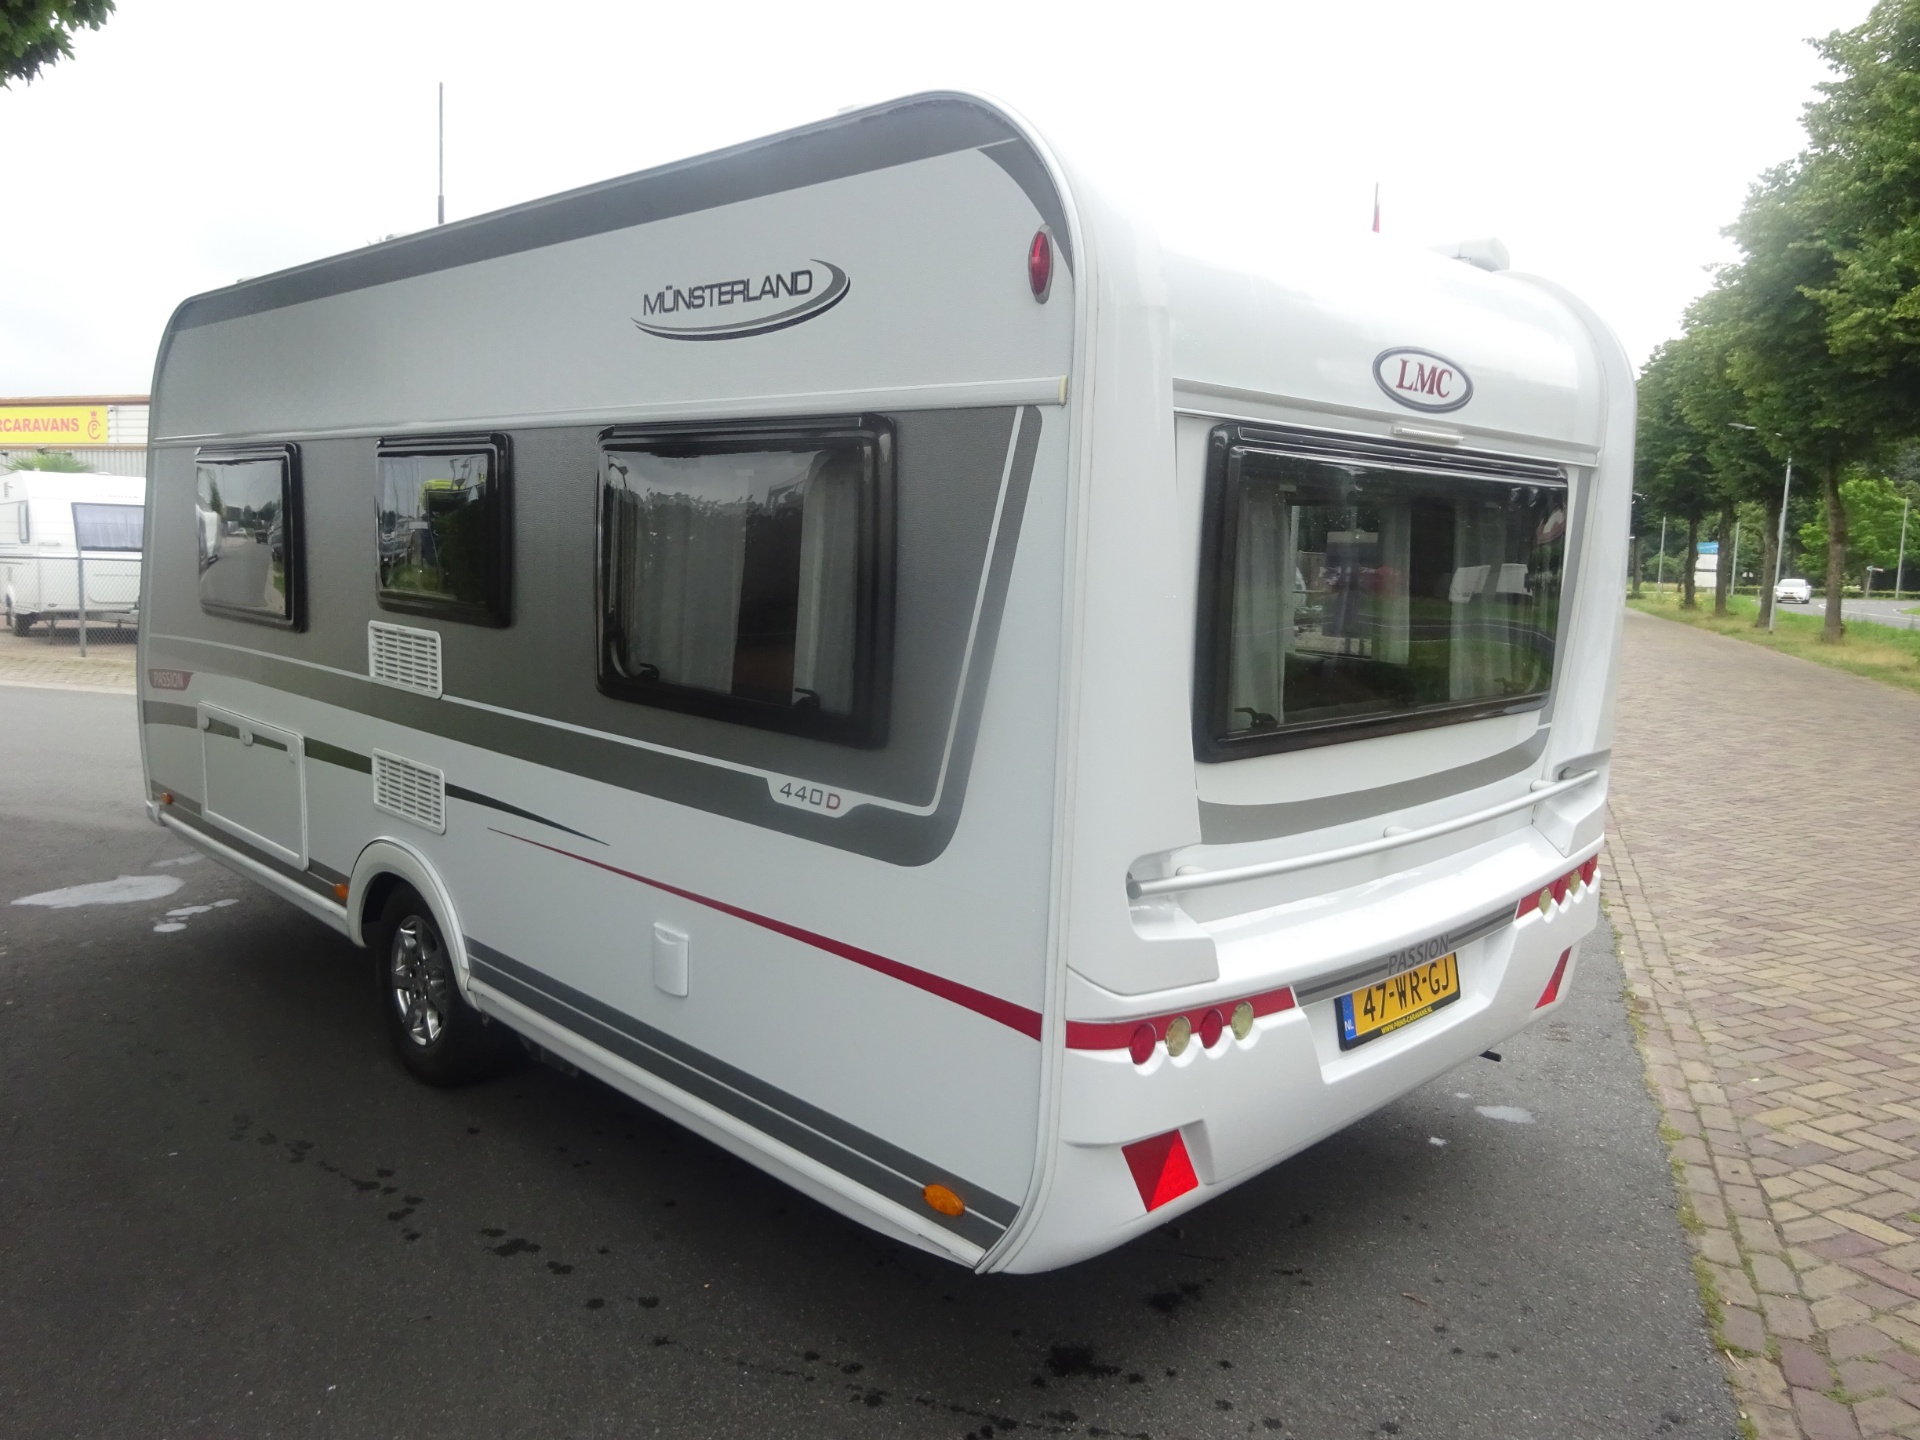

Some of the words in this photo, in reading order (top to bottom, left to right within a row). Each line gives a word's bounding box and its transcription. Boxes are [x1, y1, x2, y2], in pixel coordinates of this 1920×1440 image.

[643, 269, 813, 316] MÜNSTERLAND
[1396, 358, 1453, 398] LMC
[0, 418, 80, 432] CARAVANS
[780, 782, 841, 810] 440D
[1387, 934, 1449, 976] PASSION
[1363, 958, 1449, 1022] 47-WR-GJ
[1344, 1019, 1355, 1031] NL
